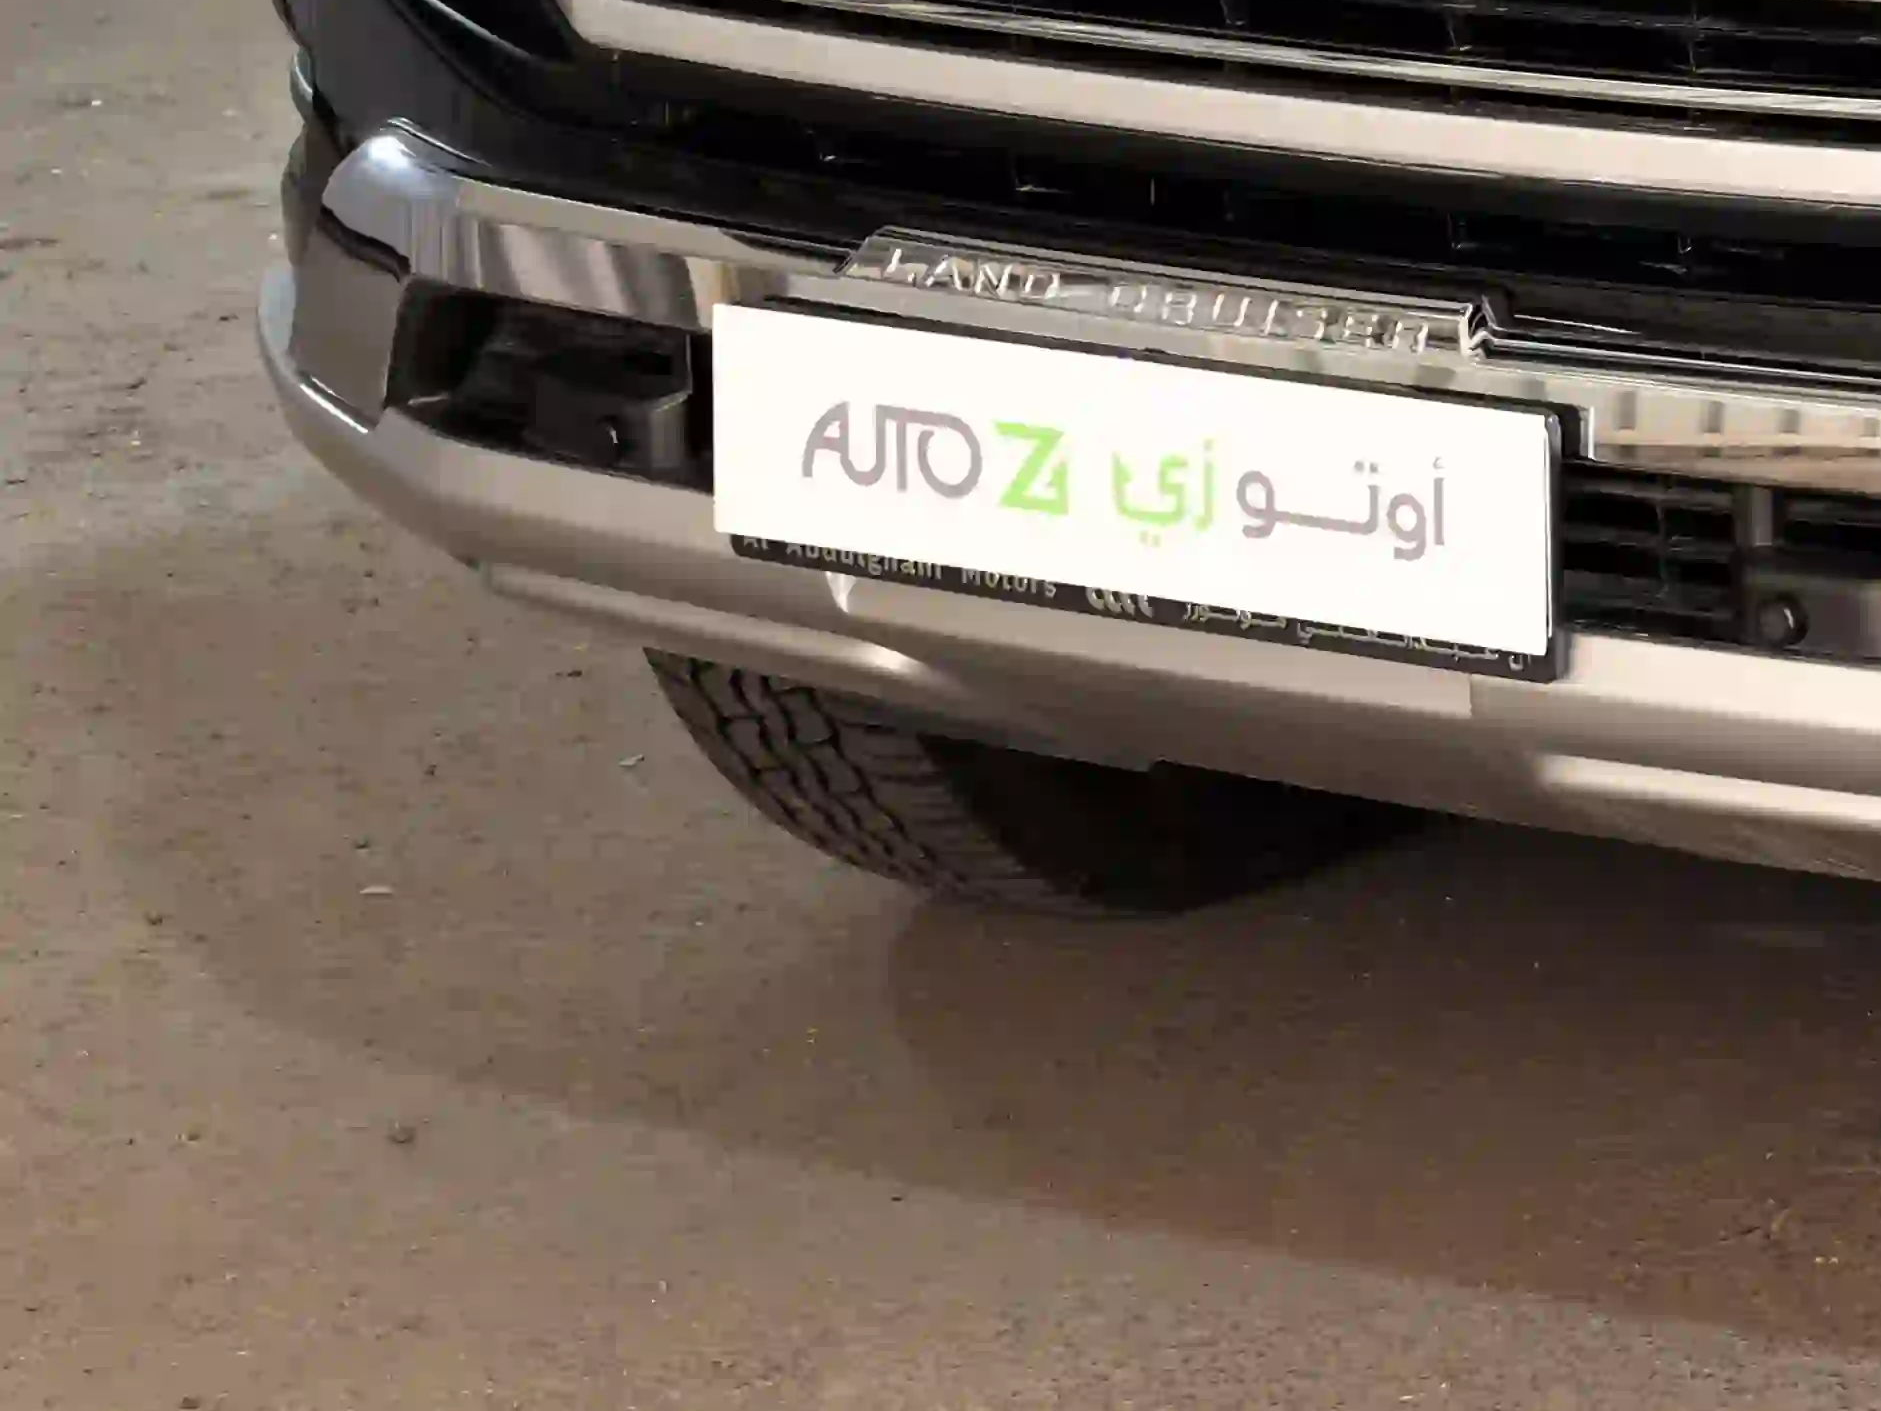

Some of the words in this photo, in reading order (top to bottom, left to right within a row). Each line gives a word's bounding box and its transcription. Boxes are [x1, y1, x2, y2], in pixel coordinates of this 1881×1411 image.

[884, 247, 1062, 301] LAND
[801, 401, 983, 499] AUTO
[1112, 439, 1217, 549] زي
